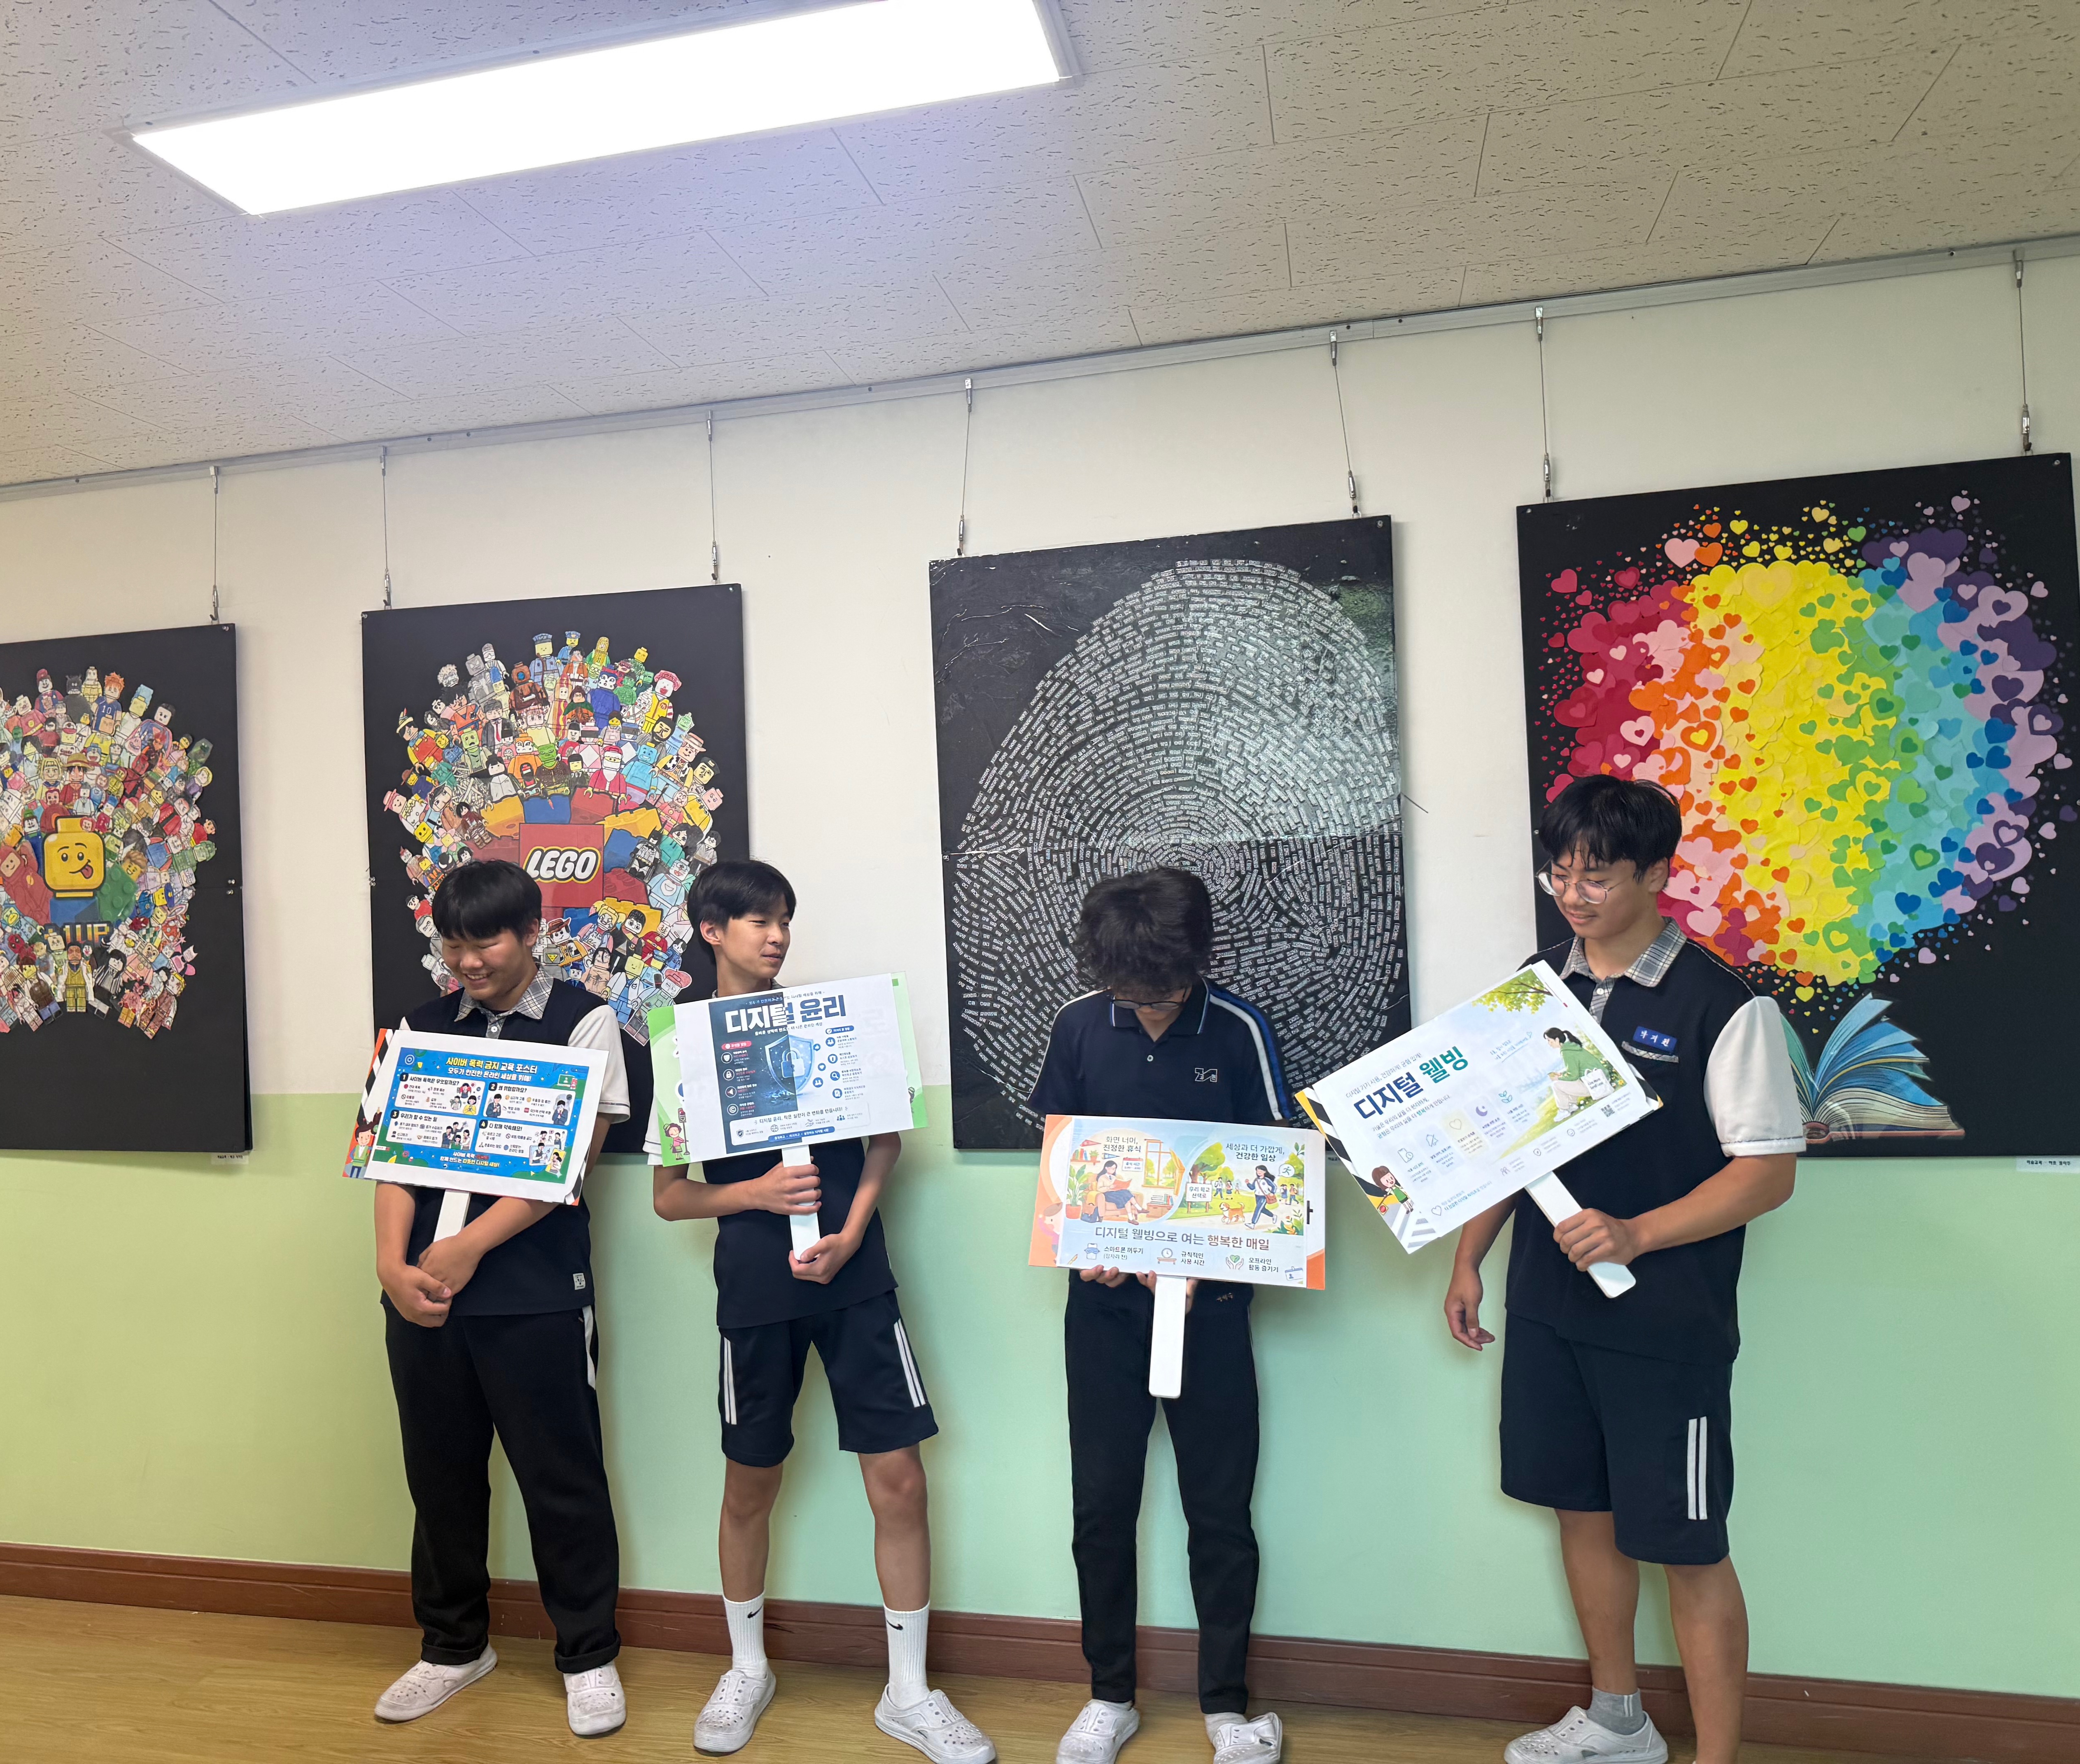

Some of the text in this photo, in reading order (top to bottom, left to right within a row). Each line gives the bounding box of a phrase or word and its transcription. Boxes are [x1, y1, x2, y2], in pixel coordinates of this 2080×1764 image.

[102, 705, 111, 714] 10
[527, 850, 596, 879] LEGO
[725, 995, 846, 1033] 디지털 윤리
[445, 1057, 538, 1074] 사이버 폭력 금지 교육 포스터
[1345, 1087, 1361, 1099] 디지털
[1359, 1081, 1371, 1091] 기기
[1354, 1071, 1424, 1119] 디지털
[1419, 1045, 1468, 1084] 웰빙
[1103, 1143, 1124, 1152] 진정한
[1260, 1145, 1285, 1154] 가깝게,
[1095, 1226, 1269, 1251] 디지털 웰빙으로 여는 행복한 매일
